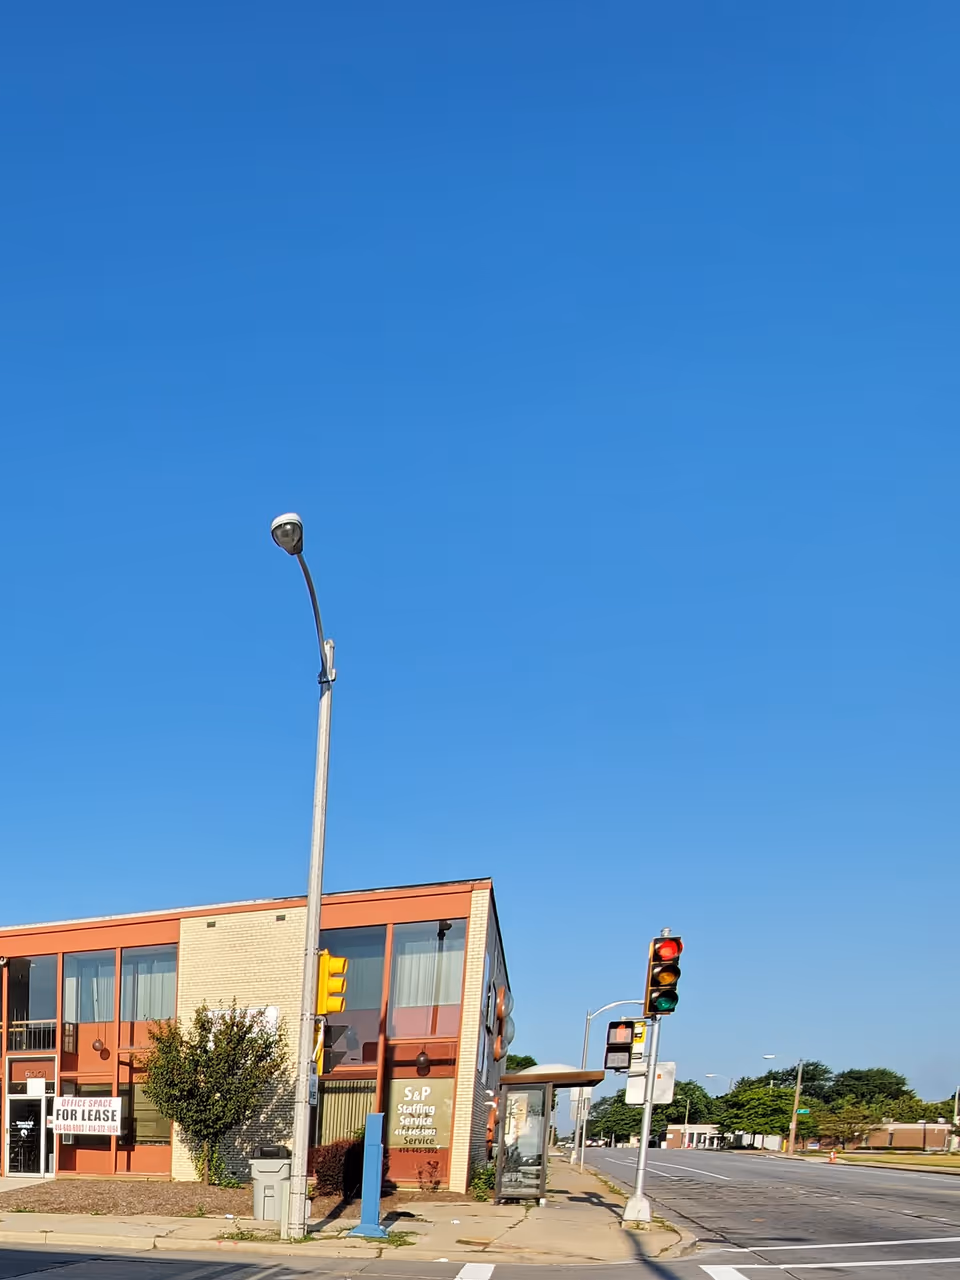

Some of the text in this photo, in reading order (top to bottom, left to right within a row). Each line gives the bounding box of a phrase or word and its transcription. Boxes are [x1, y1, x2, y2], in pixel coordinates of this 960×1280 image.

[403, 1086, 431, 1101] S&P
[61, 1099, 113, 1108] OFFICE SPACE
[397, 1103, 436, 1116] Staffing
[56, 1109, 118, 1122] FOR LEASE
[399, 1115, 433, 1125] Service
[394, 1128, 437, 1136] 414-445-5892
